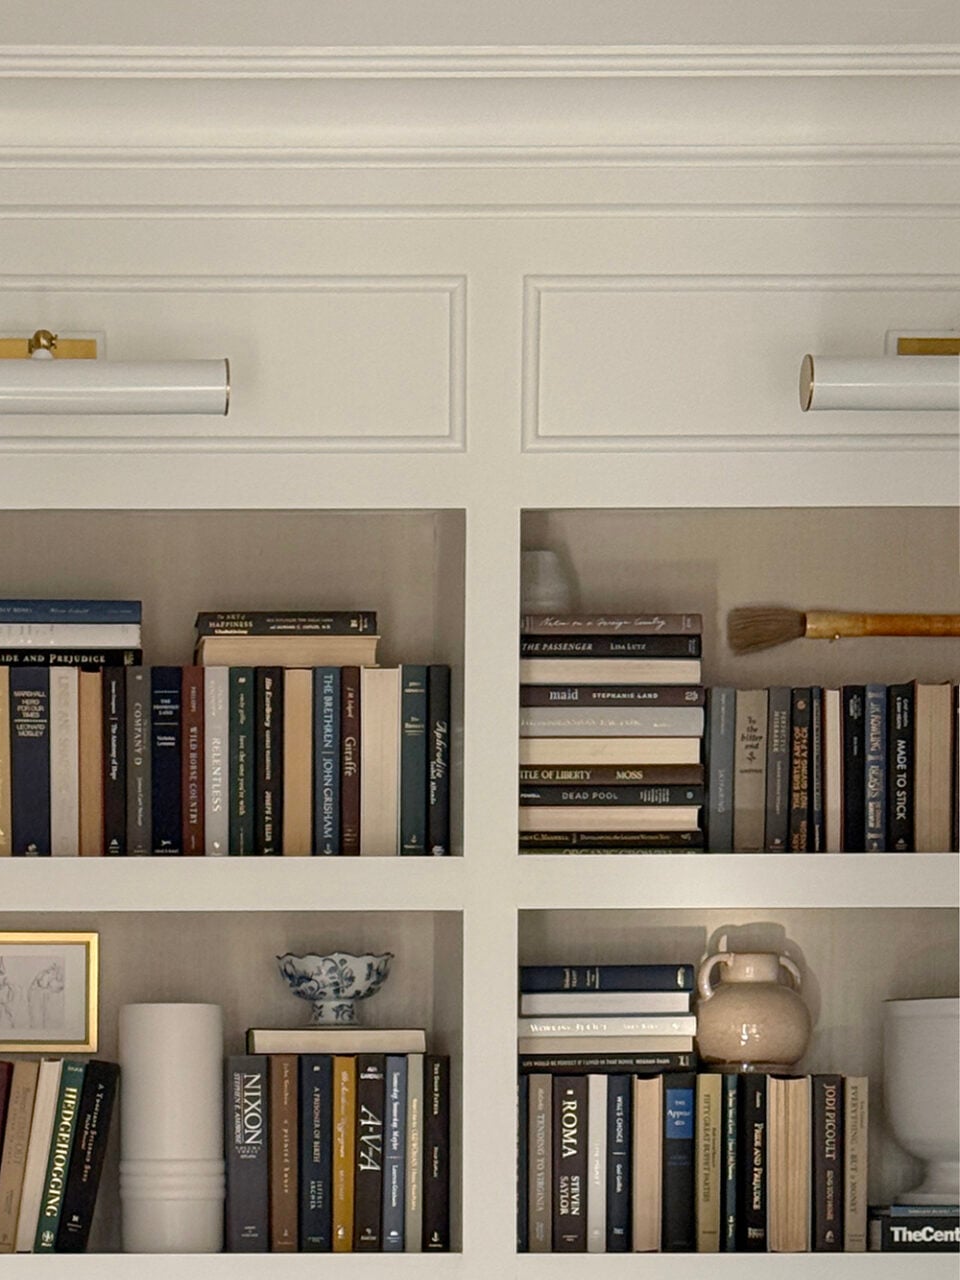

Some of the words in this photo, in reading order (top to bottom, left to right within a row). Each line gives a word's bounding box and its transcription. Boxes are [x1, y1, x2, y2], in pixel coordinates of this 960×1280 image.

[23, 655, 45, 663] AND
[49, 653, 106, 664] PREJUDICE
[522, 643, 539, 651] THE
[541, 643, 593, 651] PASSENGER
[324, 674, 334, 694] THE
[549, 689, 579, 701] maid
[134, 702, 143, 754] COMPANY
[324, 696, 334, 748] BRETHREN
[189, 727, 199, 750] WILD
[344, 736, 357, 777] Giraffe
[896, 740, 906, 769] MADE
[211, 737, 222, 812] RELENTLESS
[322, 758, 334, 785] JOHN
[541, 770, 555, 780] OF
[616, 770, 643, 780] MOSS
[896, 774, 906, 789] TO
[189, 784, 199, 825] COUNTRY
[562, 792, 589, 800] DEAD
[591, 792, 618, 800] POOL
[896, 791, 906, 820] STICK
[324, 787, 334, 838] GRISHAM
[244, 1072, 262, 1145] NIXON
[823, 1084, 836, 1110] JODI
[562, 1099, 578, 1158] ROMA
[824, 1112, 836, 1160] PICOULT
[45, 1086, 79, 1217] HEDGEHOGGING
[559, 1175, 570, 1215] SAYLOR
[570, 1175, 580, 1215] STEVEN
[889, 1226, 960, 1242] TheCent
